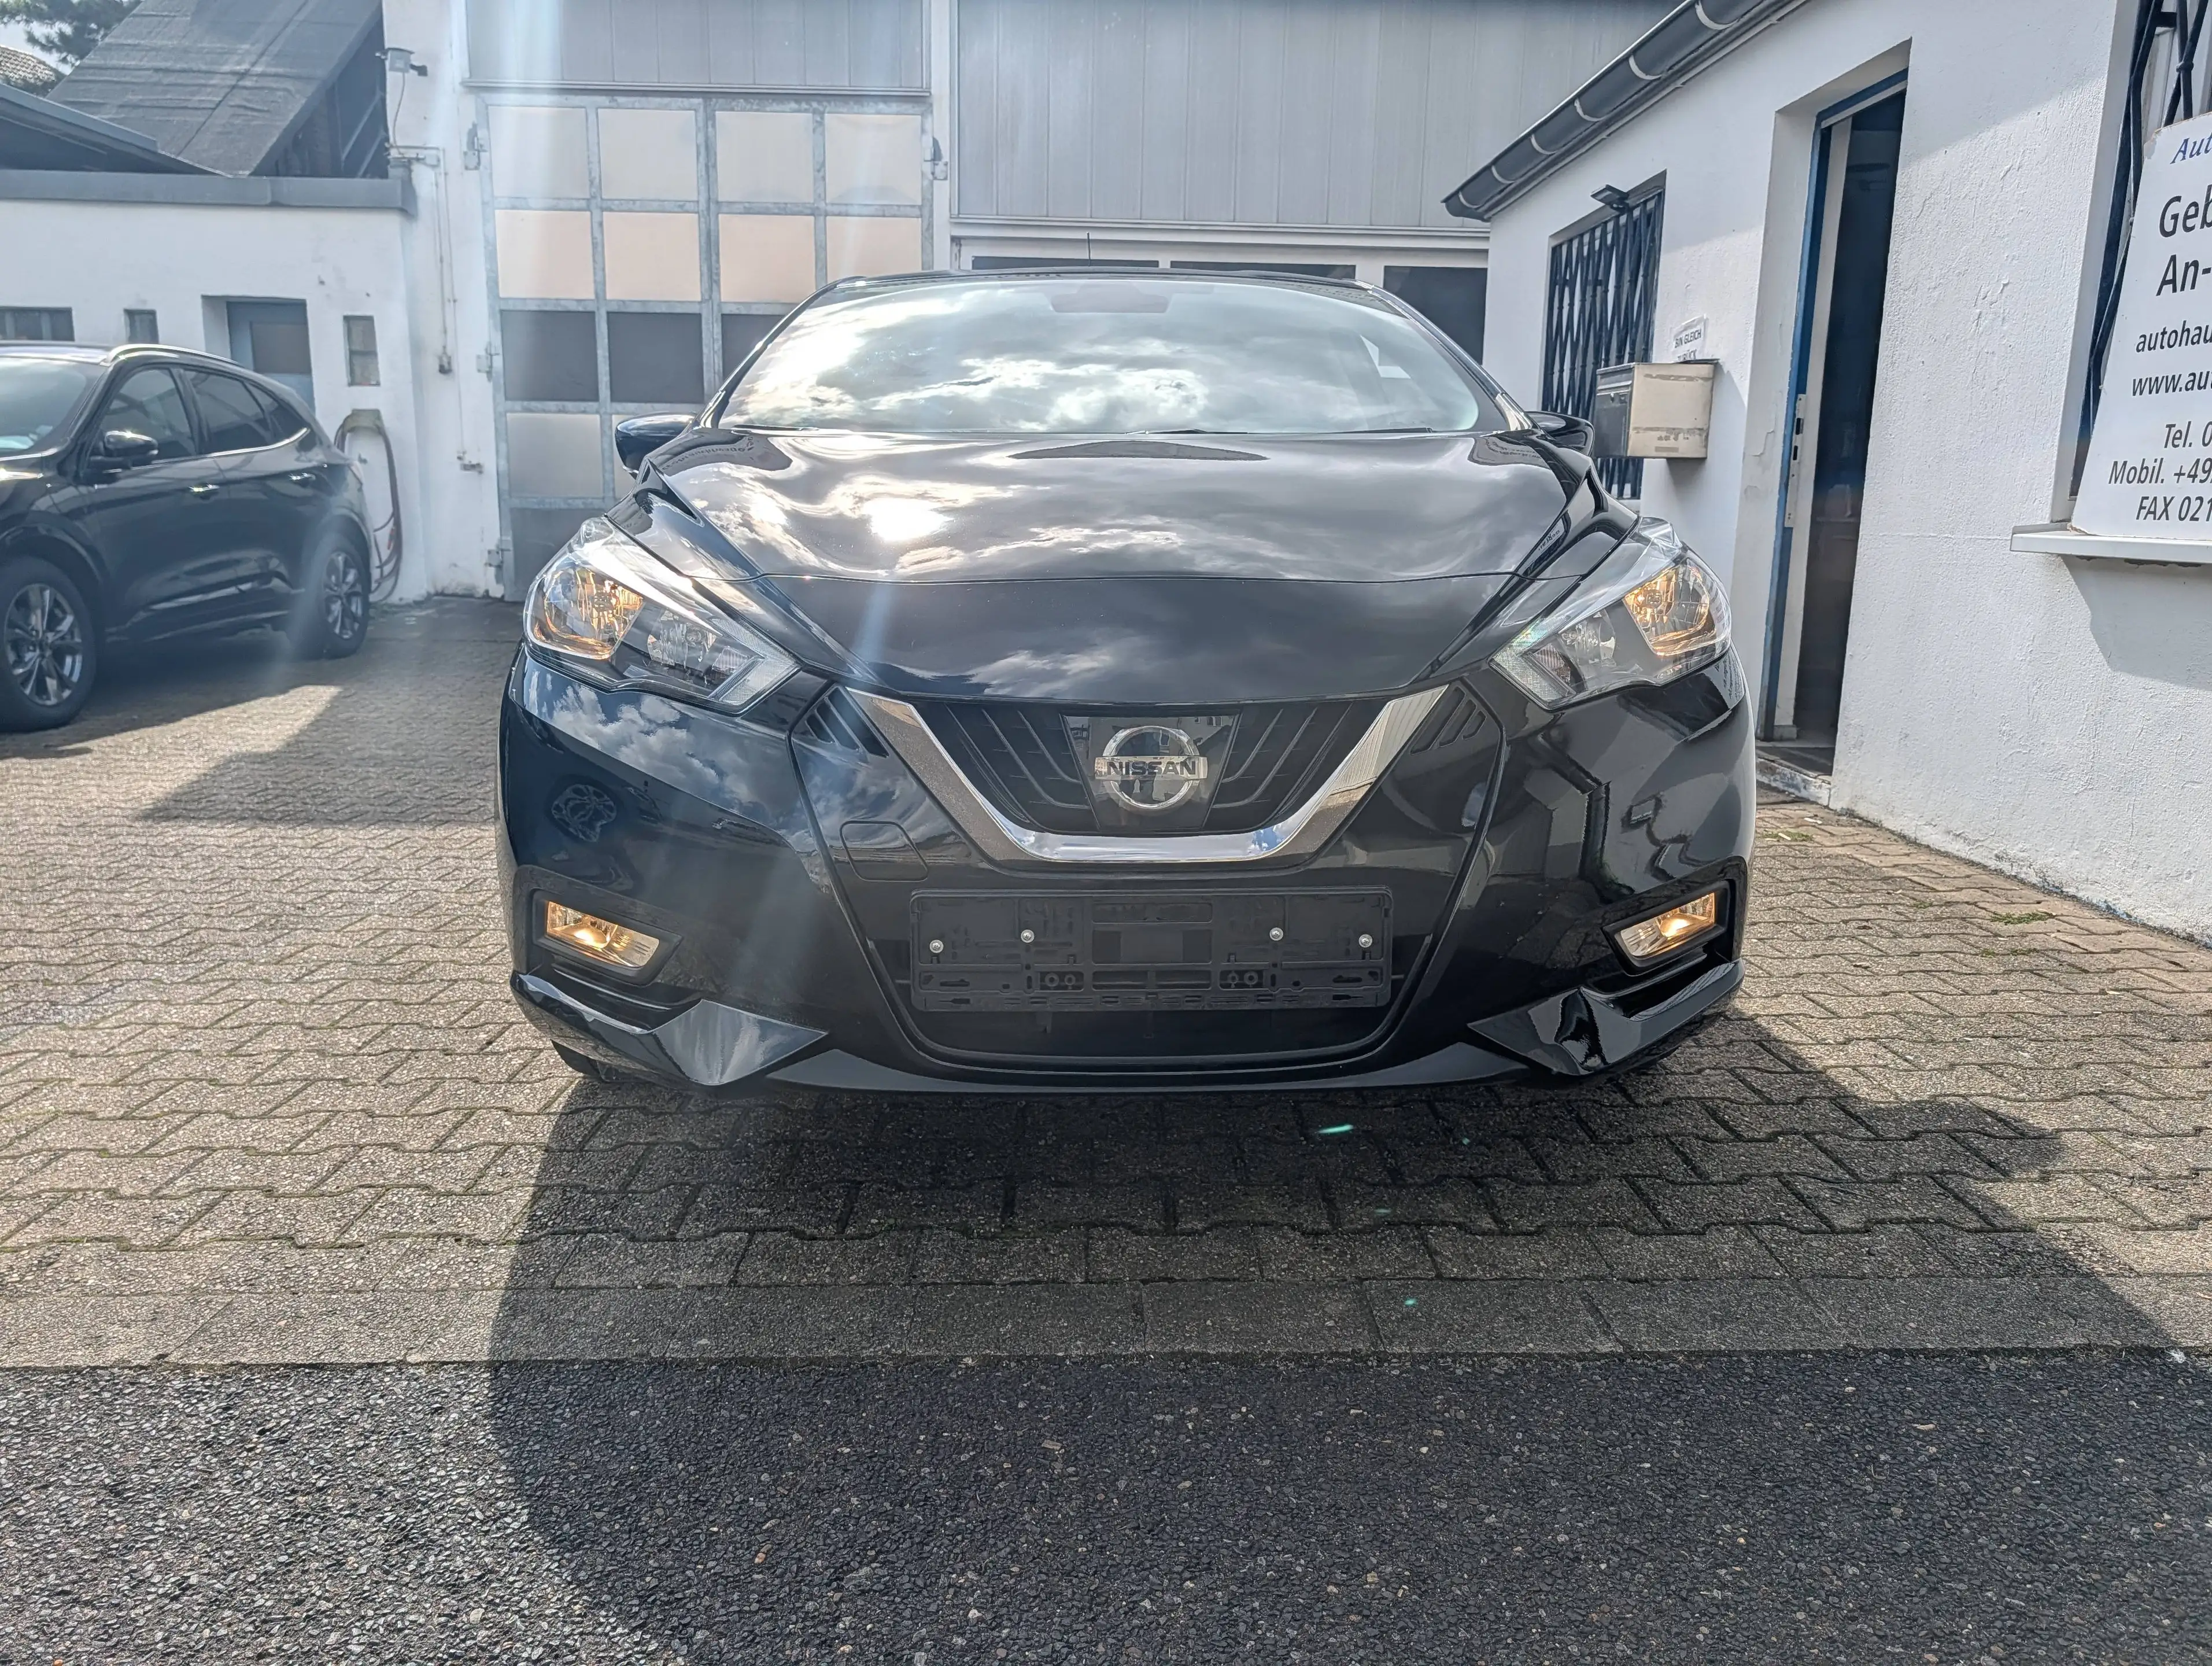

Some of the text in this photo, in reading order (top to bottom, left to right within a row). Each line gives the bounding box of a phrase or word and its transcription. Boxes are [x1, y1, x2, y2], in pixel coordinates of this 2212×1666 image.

[2156, 255, 2212, 297] An-
[2136, 320, 2212, 353] autohau
[2132, 370, 2212, 396] www.au
[2164, 421, 2192, 448] Tel.
[2108, 458, 2165, 484] Mobil.
[2136, 496, 2176, 521] FAX
[1107, 761, 1197, 775] NISSAN
